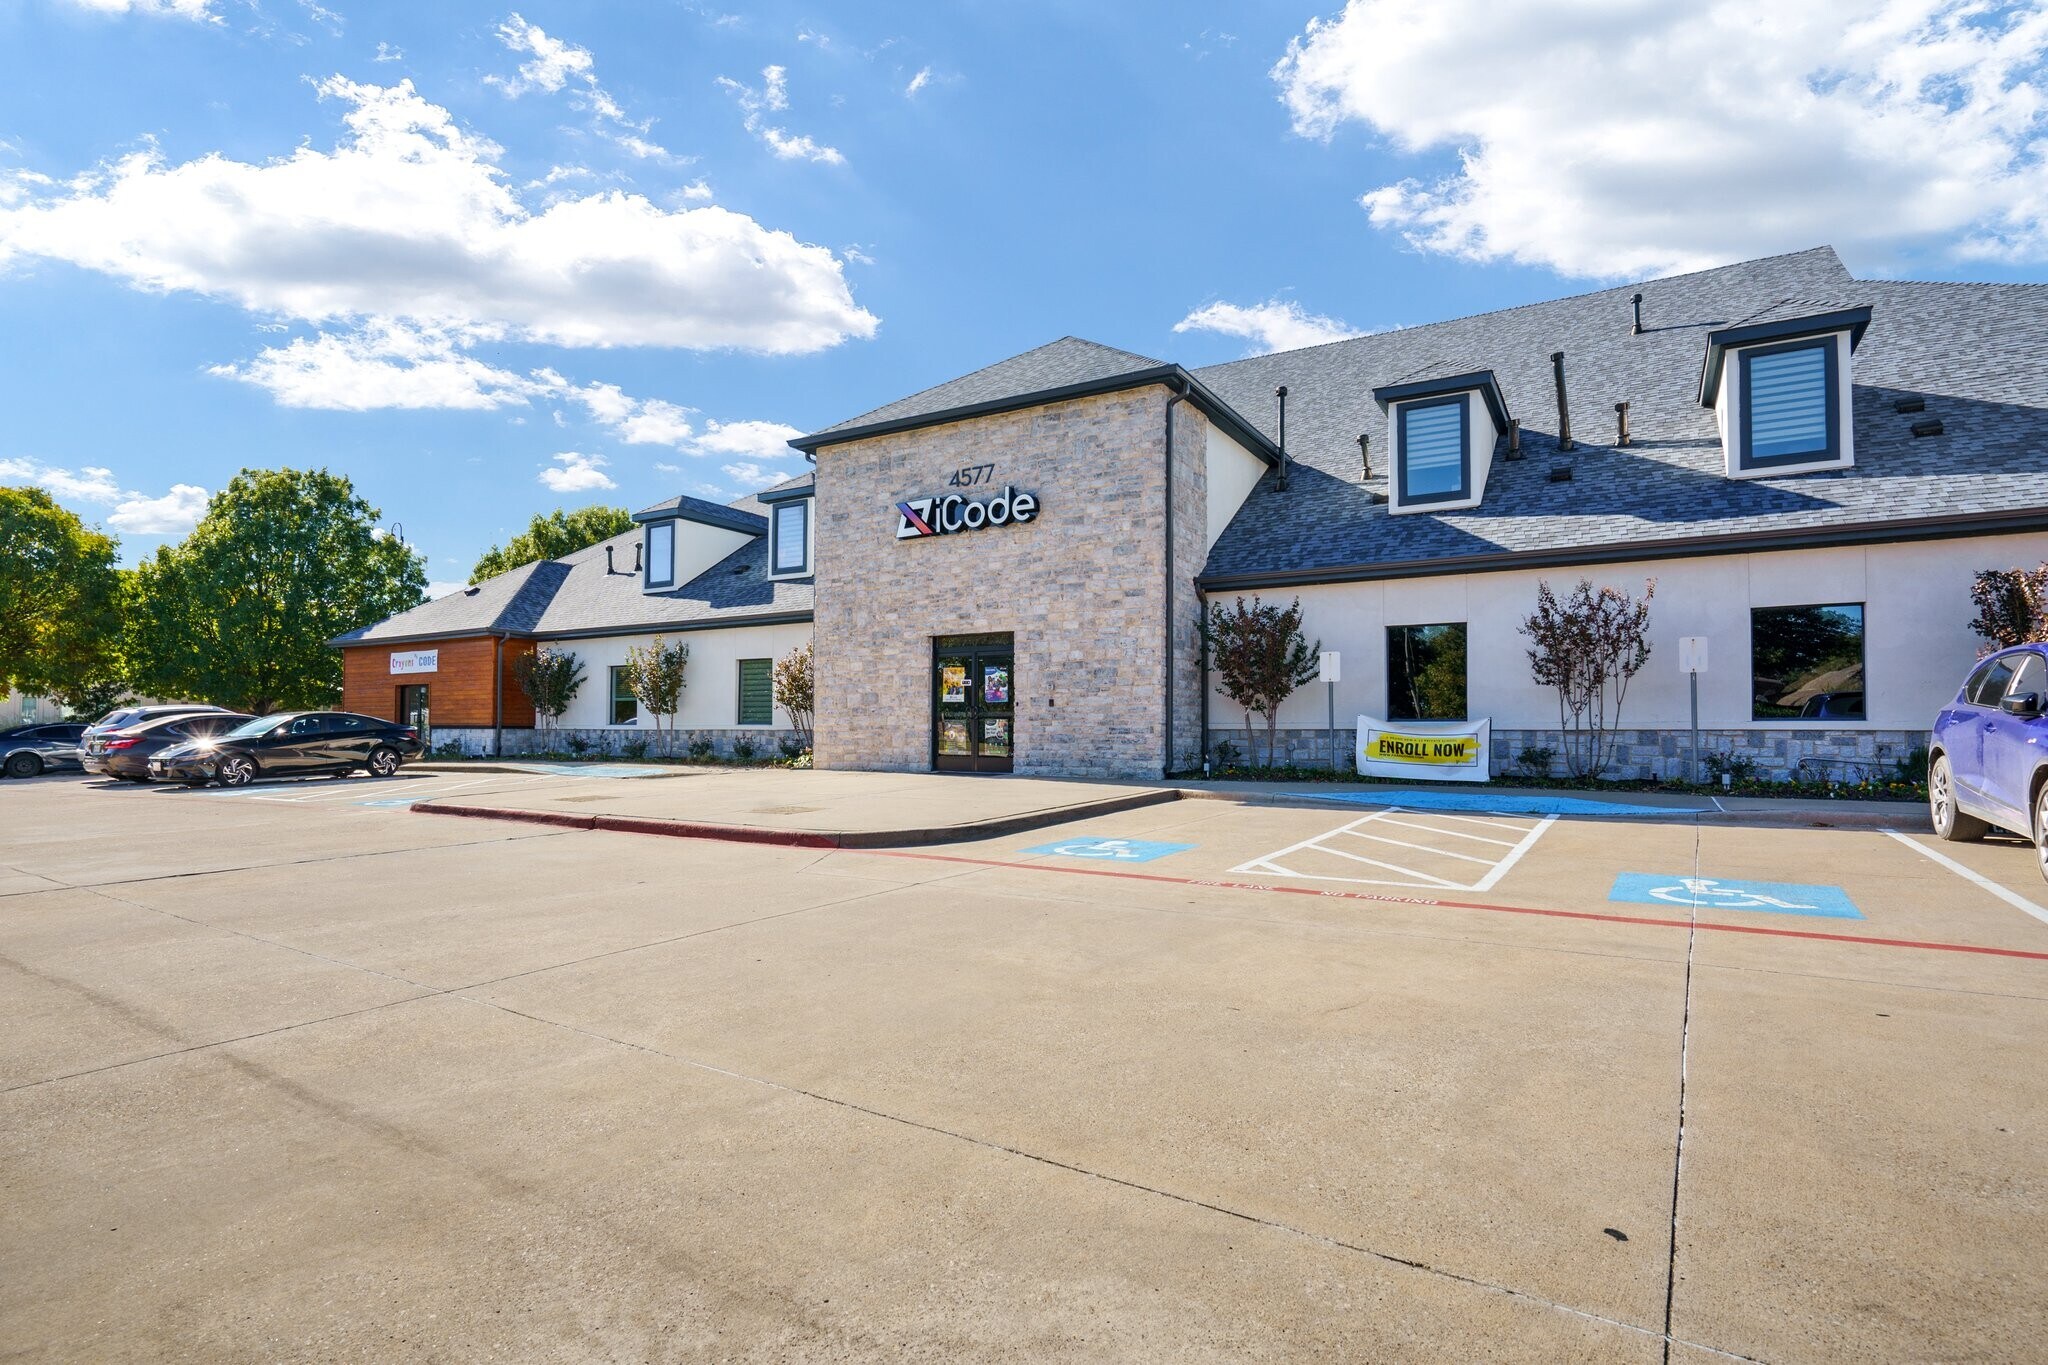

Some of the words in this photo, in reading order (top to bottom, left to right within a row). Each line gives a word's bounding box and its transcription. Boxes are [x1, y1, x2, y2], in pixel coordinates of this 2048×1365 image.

[949, 463, 995, 487] 4577
[935, 486, 1038, 532] iCode
[418, 655, 437, 667] CODE
[1379, 740, 1429, 756] ENROLL
[1433, 743, 1465, 757] NOW
[1187, 879, 1222, 887] FIRE
[1355, 893, 1439, 905] PARKING
